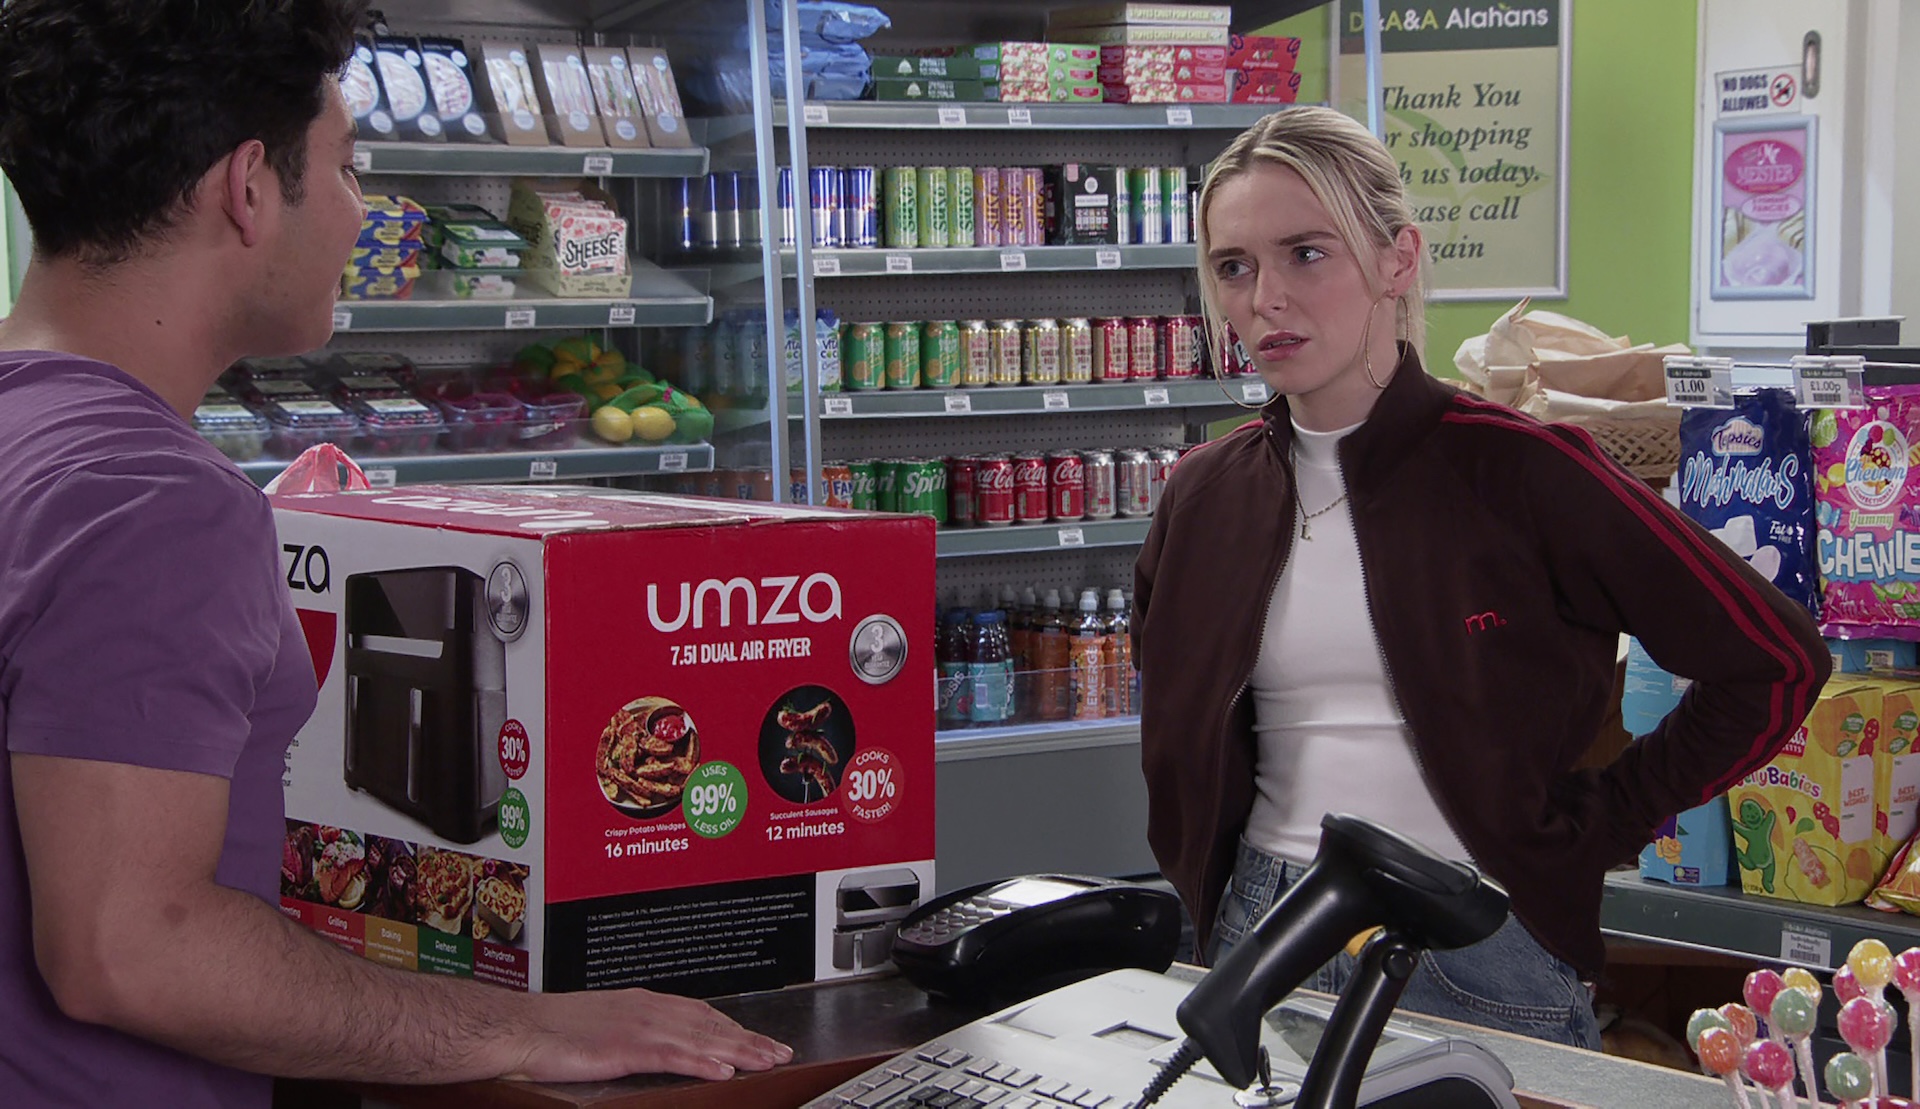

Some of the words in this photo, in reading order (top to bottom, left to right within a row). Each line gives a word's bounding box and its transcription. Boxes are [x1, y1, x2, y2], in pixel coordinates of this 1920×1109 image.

[1445, 6, 1549, 30] Alahans
[1723, 77, 1737, 92] NO
[1739, 74, 1768, 91] DOGS
[1382, 83, 1462, 112] Thank
[1474, 83, 1521, 108] You
[1722, 95, 1768, 112] ALLOWED
[1408, 120, 1532, 152] shopping
[1422, 167, 1450, 185] us
[1459, 158, 1541, 188] today.
[1469, 196, 1521, 221] call
[562, 231, 620, 269] SHEESE
[1429, 235, 1484, 264] gain
[1674, 379, 1705, 393] £1.00
[1810, 380, 1841, 393] £1.00p
[903, 467, 947, 498] Sprit
[1849, 509, 1895, 531] Yummy
[500, 567, 513, 603] 3
[647, 572, 843, 633] umza
[871, 625, 885, 653] 3
[701, 641, 738, 664] DUAL
[740, 639, 764, 661] AIR
[768, 636, 811, 659] FRYER
[505, 721, 523, 735] COOKS
[501, 735, 526, 762] 30%
[856, 750, 890, 767] COOKS
[702, 765, 728, 779] USES
[848, 768, 896, 802] 30%
[1847, 787, 1865, 799] BEST
[1897, 785, 1916, 796] BEST
[690, 782, 737, 816] 99%
[501, 805, 525, 832] 99%
[770, 809, 804, 821] Succulent
[805, 807, 839, 818] Sausages
[852, 801, 892, 820] FASTER!
[605, 828, 628, 838] Crispy
[629, 825, 656, 836] Potato
[656, 821, 687, 833] Wedges
[693, 818, 719, 835] LESS
[719, 818, 737, 832] OIL
[766, 826, 783, 841] 12
[786, 820, 845, 840] minutes
[605, 842, 623, 859] 16
[627, 837, 689, 857] minutes
[327, 915, 348, 931] Grilling
[381, 928, 402, 943] Baking
[435, 939, 457, 954] Reheat
[484, 946, 515, 962] Dehydrate
